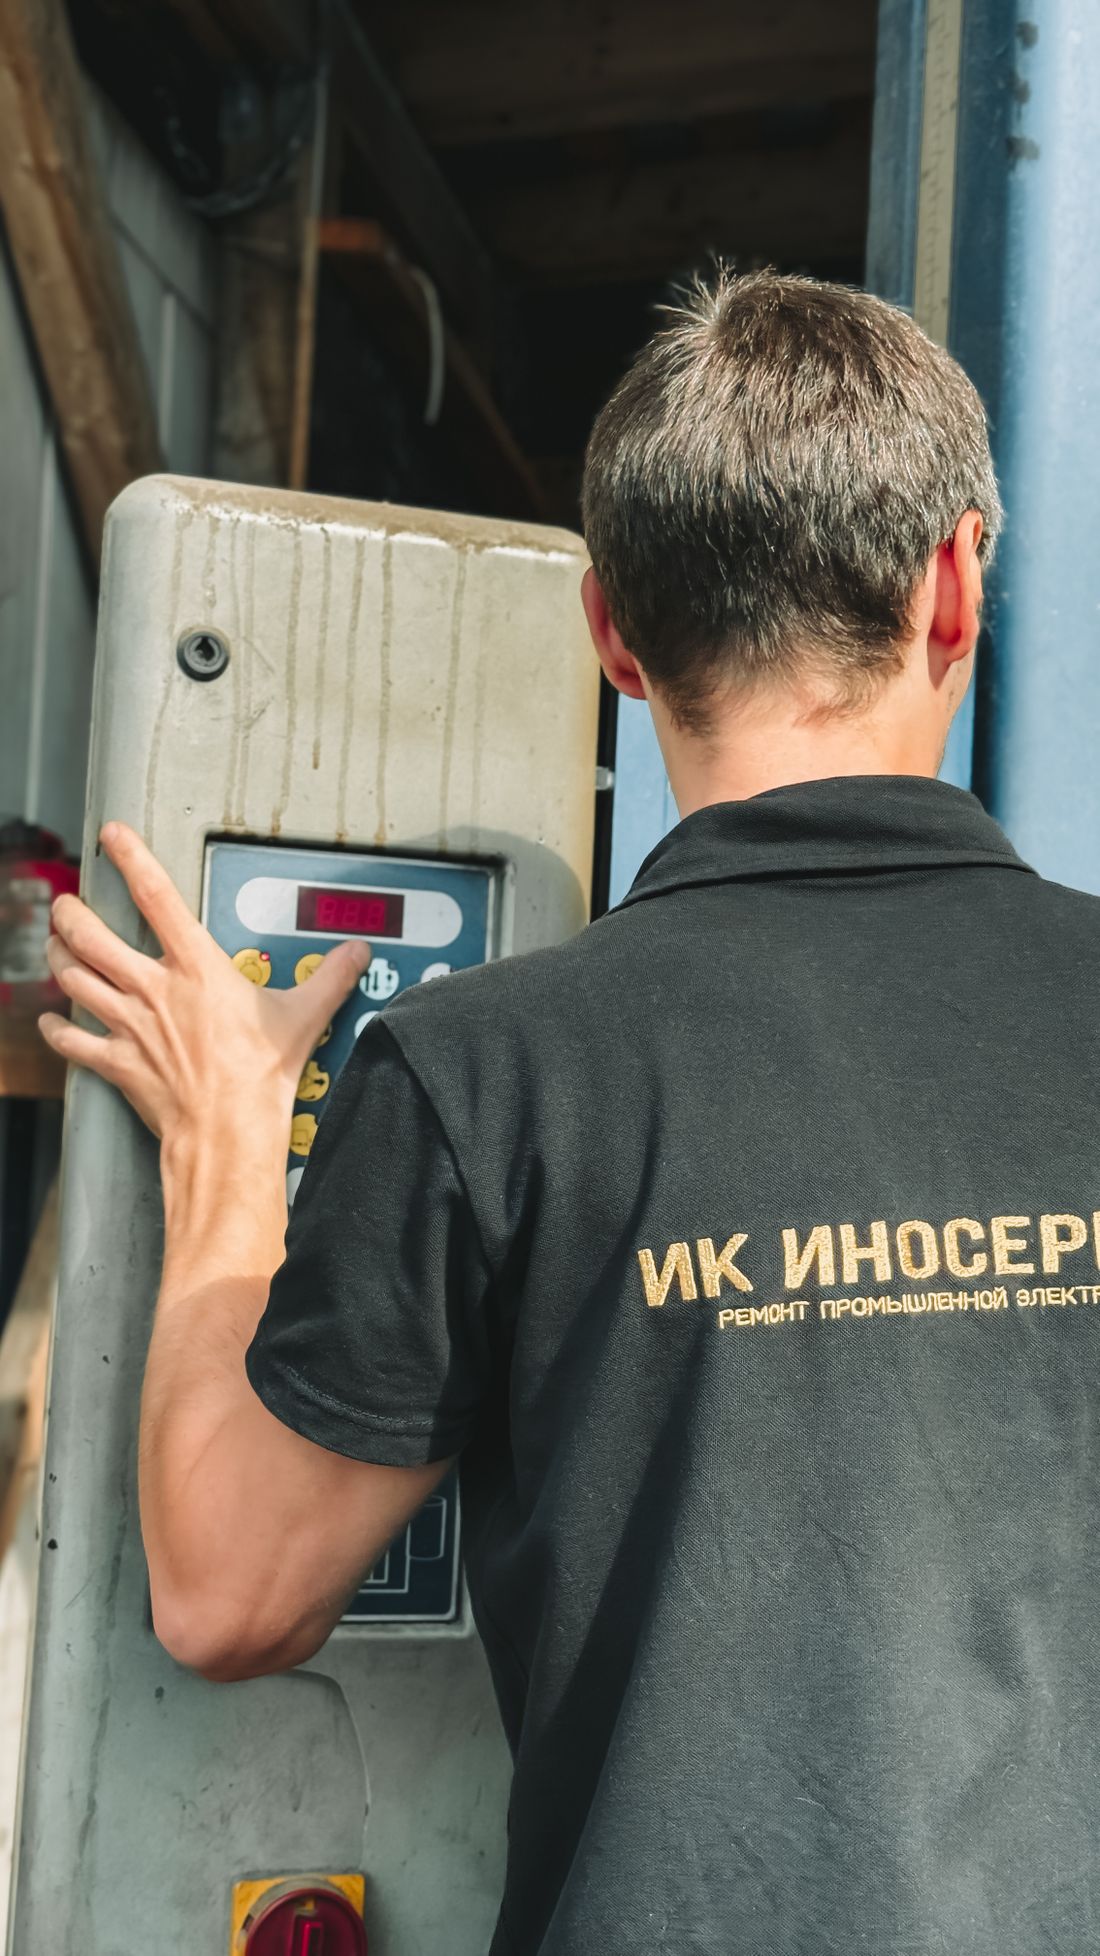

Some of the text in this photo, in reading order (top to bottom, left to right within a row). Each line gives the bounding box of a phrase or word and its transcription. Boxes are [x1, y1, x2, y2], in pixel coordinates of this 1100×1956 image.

[638, 1211, 1100, 1307] ИК ИНОСЕР
[718, 1300, 809, 1329] РЕМОНТ
[819, 1285, 1008, 1320] ПРОМЫШЛЕННОЙ
